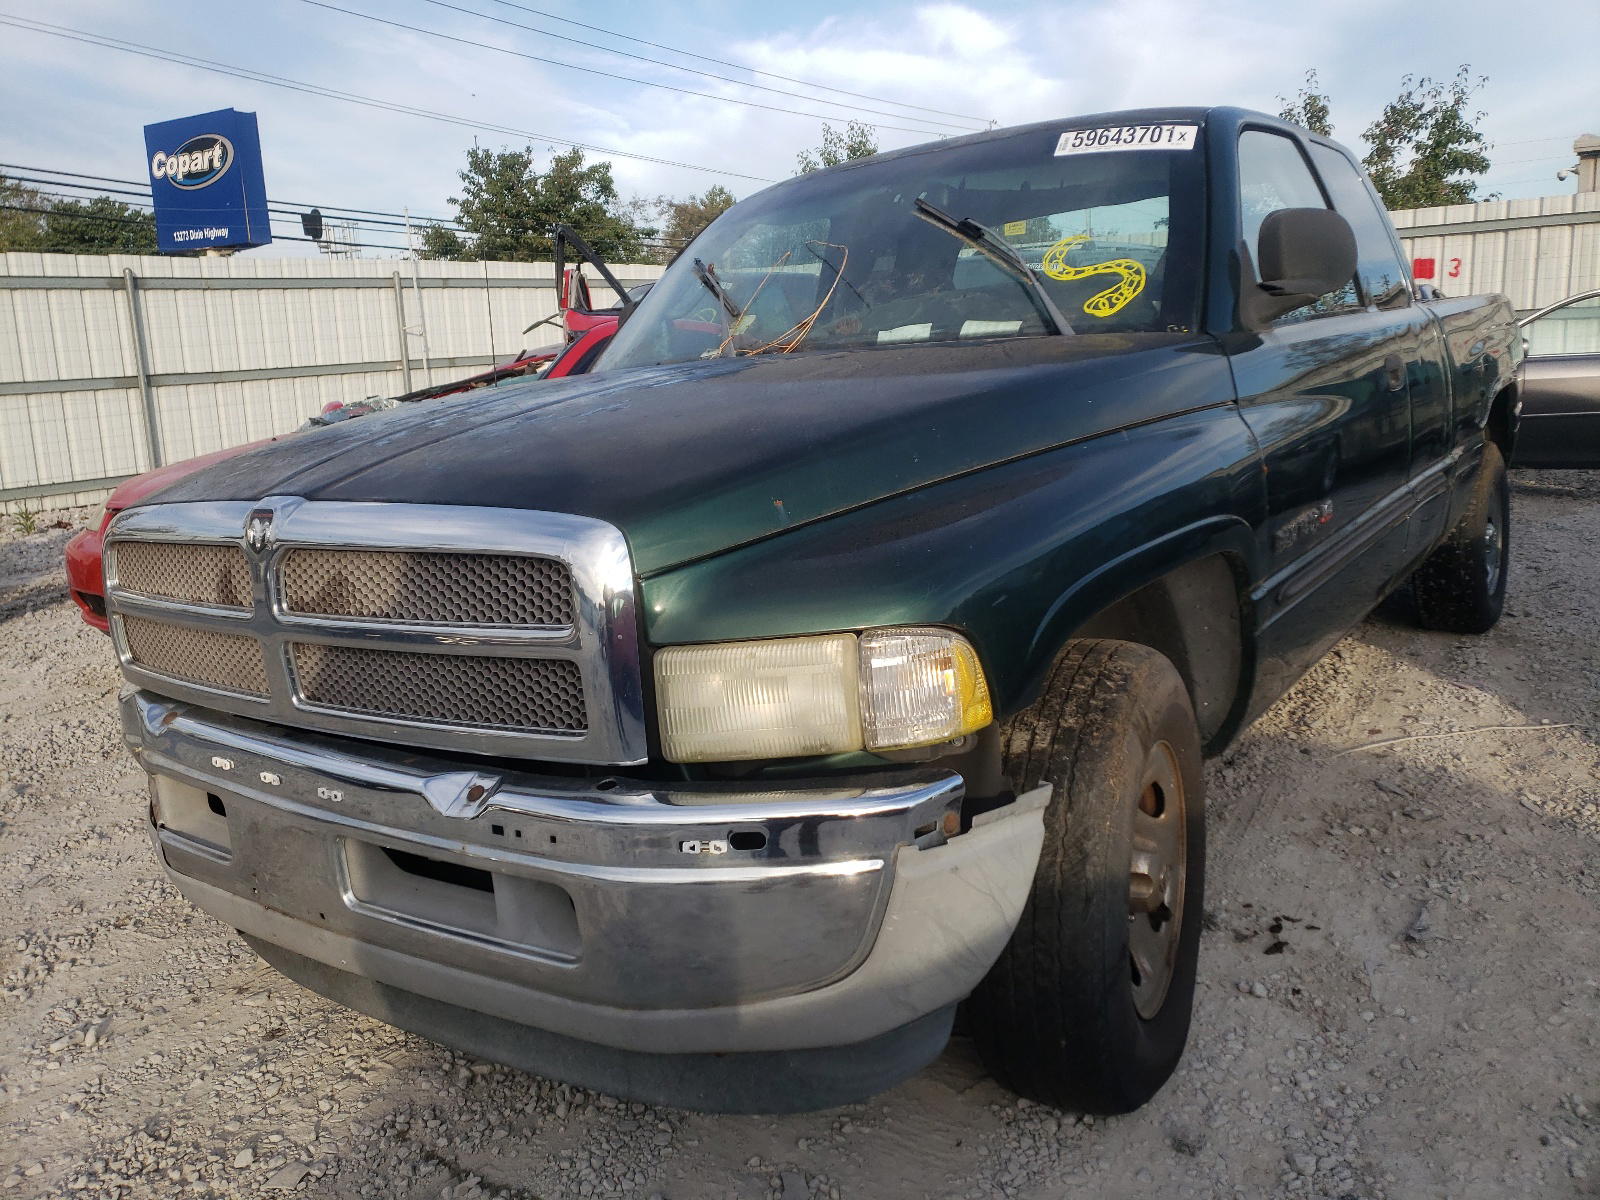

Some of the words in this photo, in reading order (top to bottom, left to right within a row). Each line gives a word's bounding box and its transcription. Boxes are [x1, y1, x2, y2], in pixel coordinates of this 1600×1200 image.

[1071, 126, 1176, 148] 59643701
[152, 140, 223, 182] Copart
[190, 229, 203, 240] Dixie
[204, 227, 229, 240] Highway
[1448, 257, 1462, 278] 3
